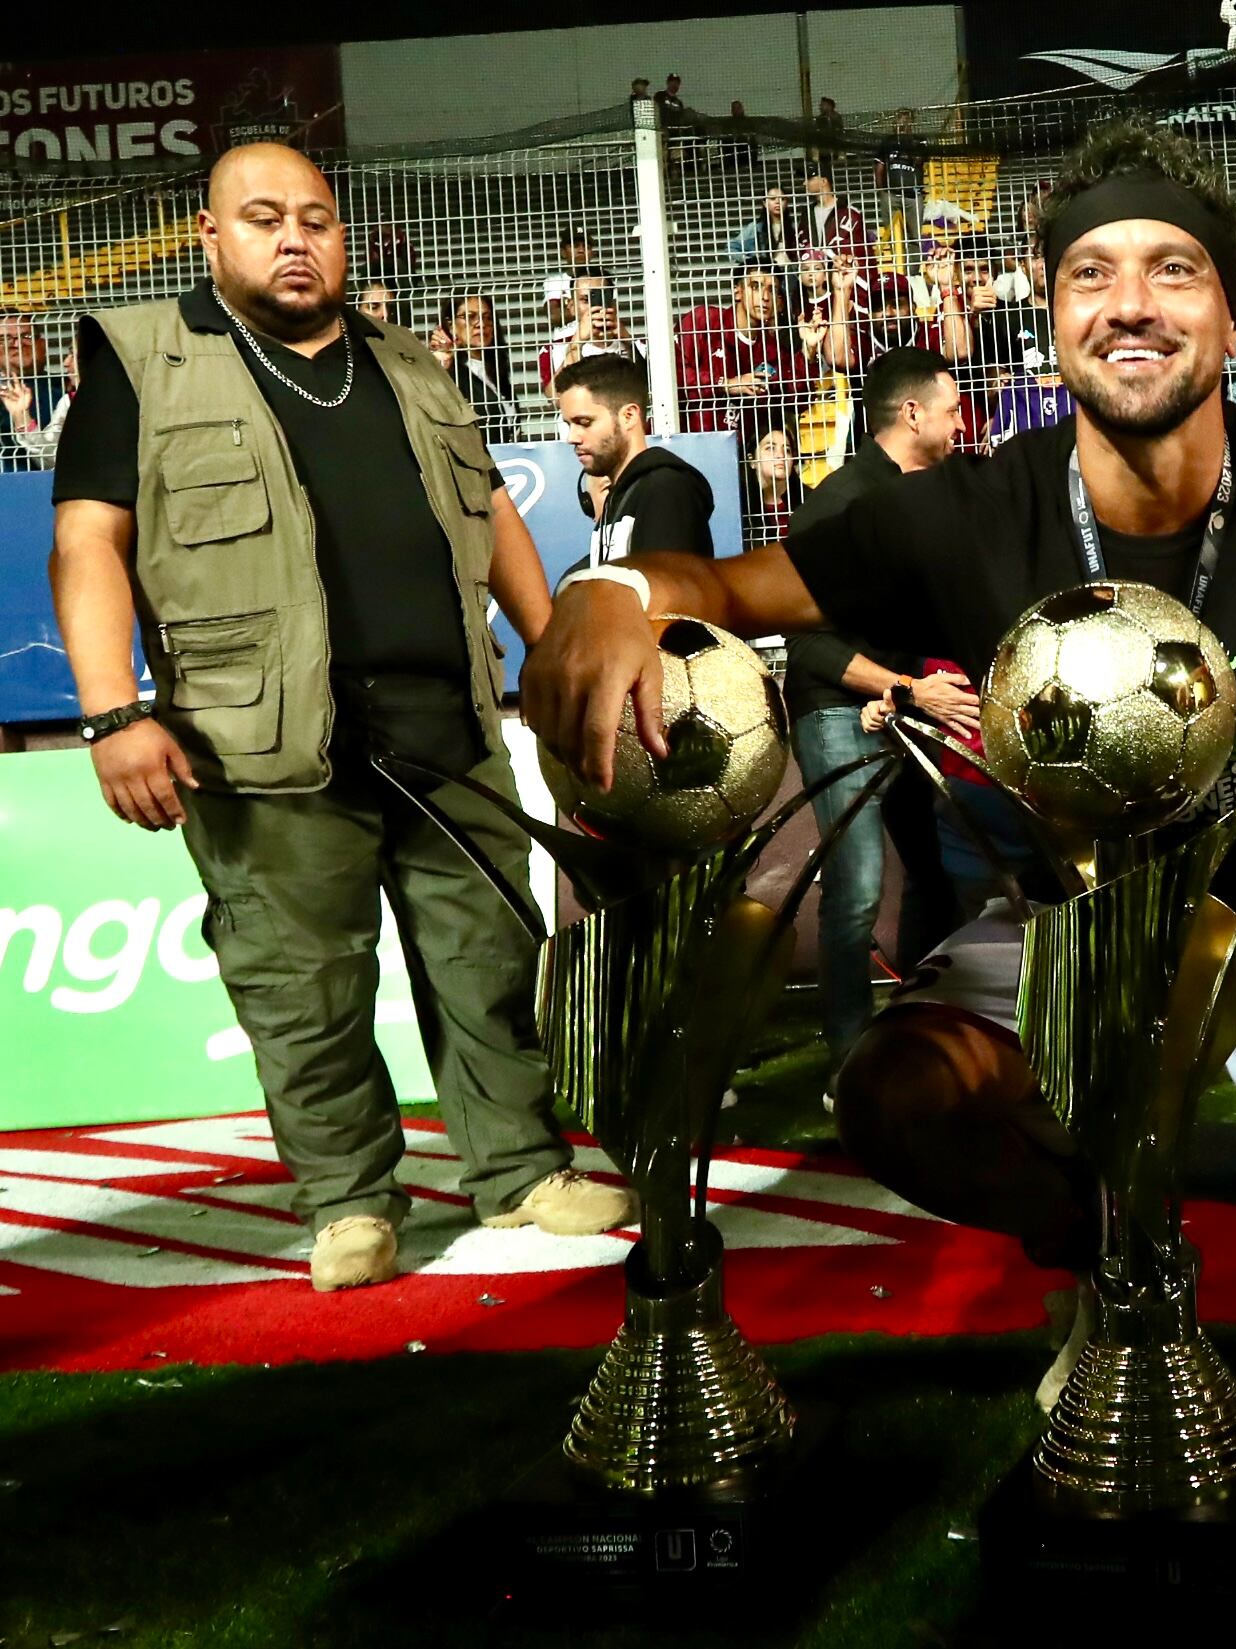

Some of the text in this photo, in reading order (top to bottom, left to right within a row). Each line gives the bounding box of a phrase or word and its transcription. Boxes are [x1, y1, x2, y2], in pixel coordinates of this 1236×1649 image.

[39, 78, 195, 114] FUTUROS
[229, 124, 277, 138] ESCUELAS
[1216, 469, 1233, 504] 2023
[1080, 527, 1100, 574] UNAFUT
[1191, 574, 1209, 616] UNAFU
[591, 1544, 635, 1553] SAPRISSA
